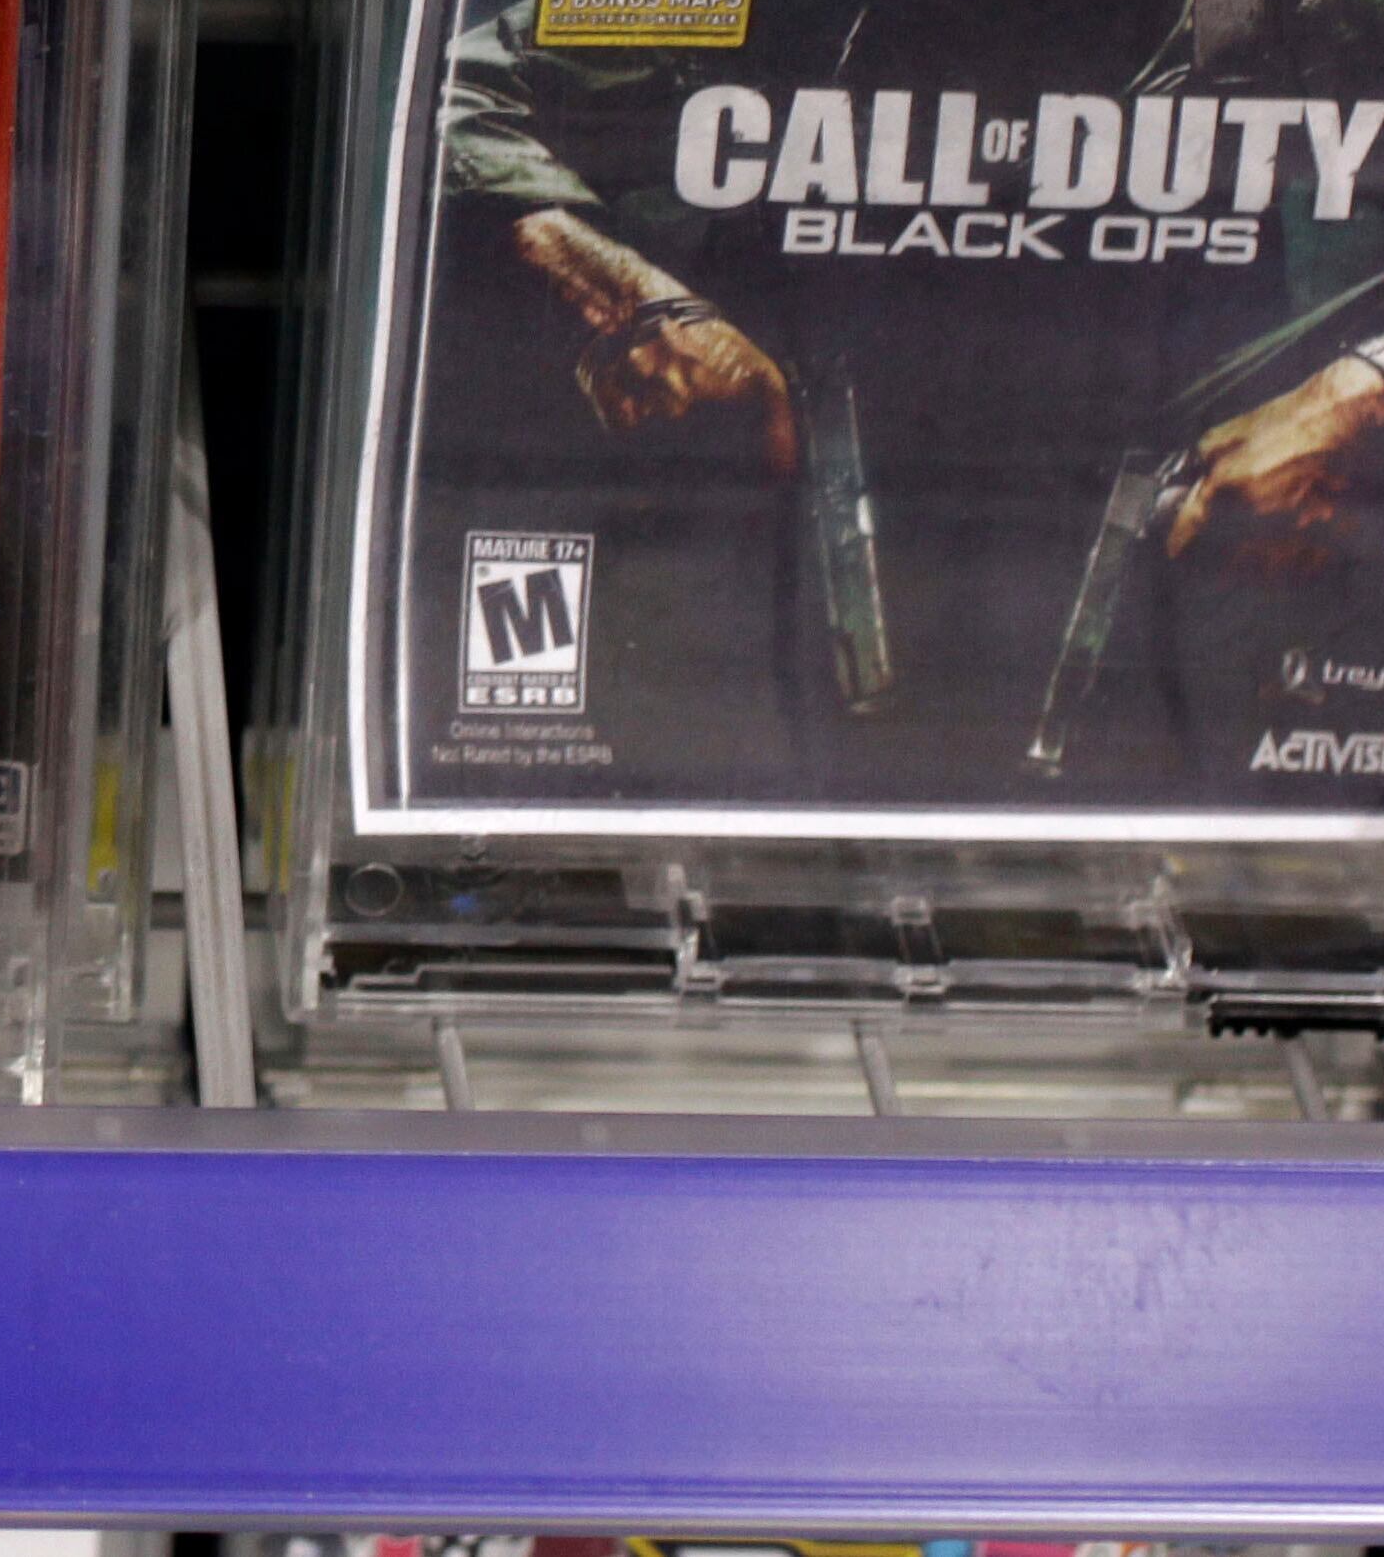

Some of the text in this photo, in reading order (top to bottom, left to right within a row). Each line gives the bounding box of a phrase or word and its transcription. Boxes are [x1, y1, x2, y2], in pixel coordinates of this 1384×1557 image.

[674, 85, 1384, 221] CALL OF DUTY
[782, 210, 1259, 263] BLACK OPS
[477, 568, 576, 665] M
